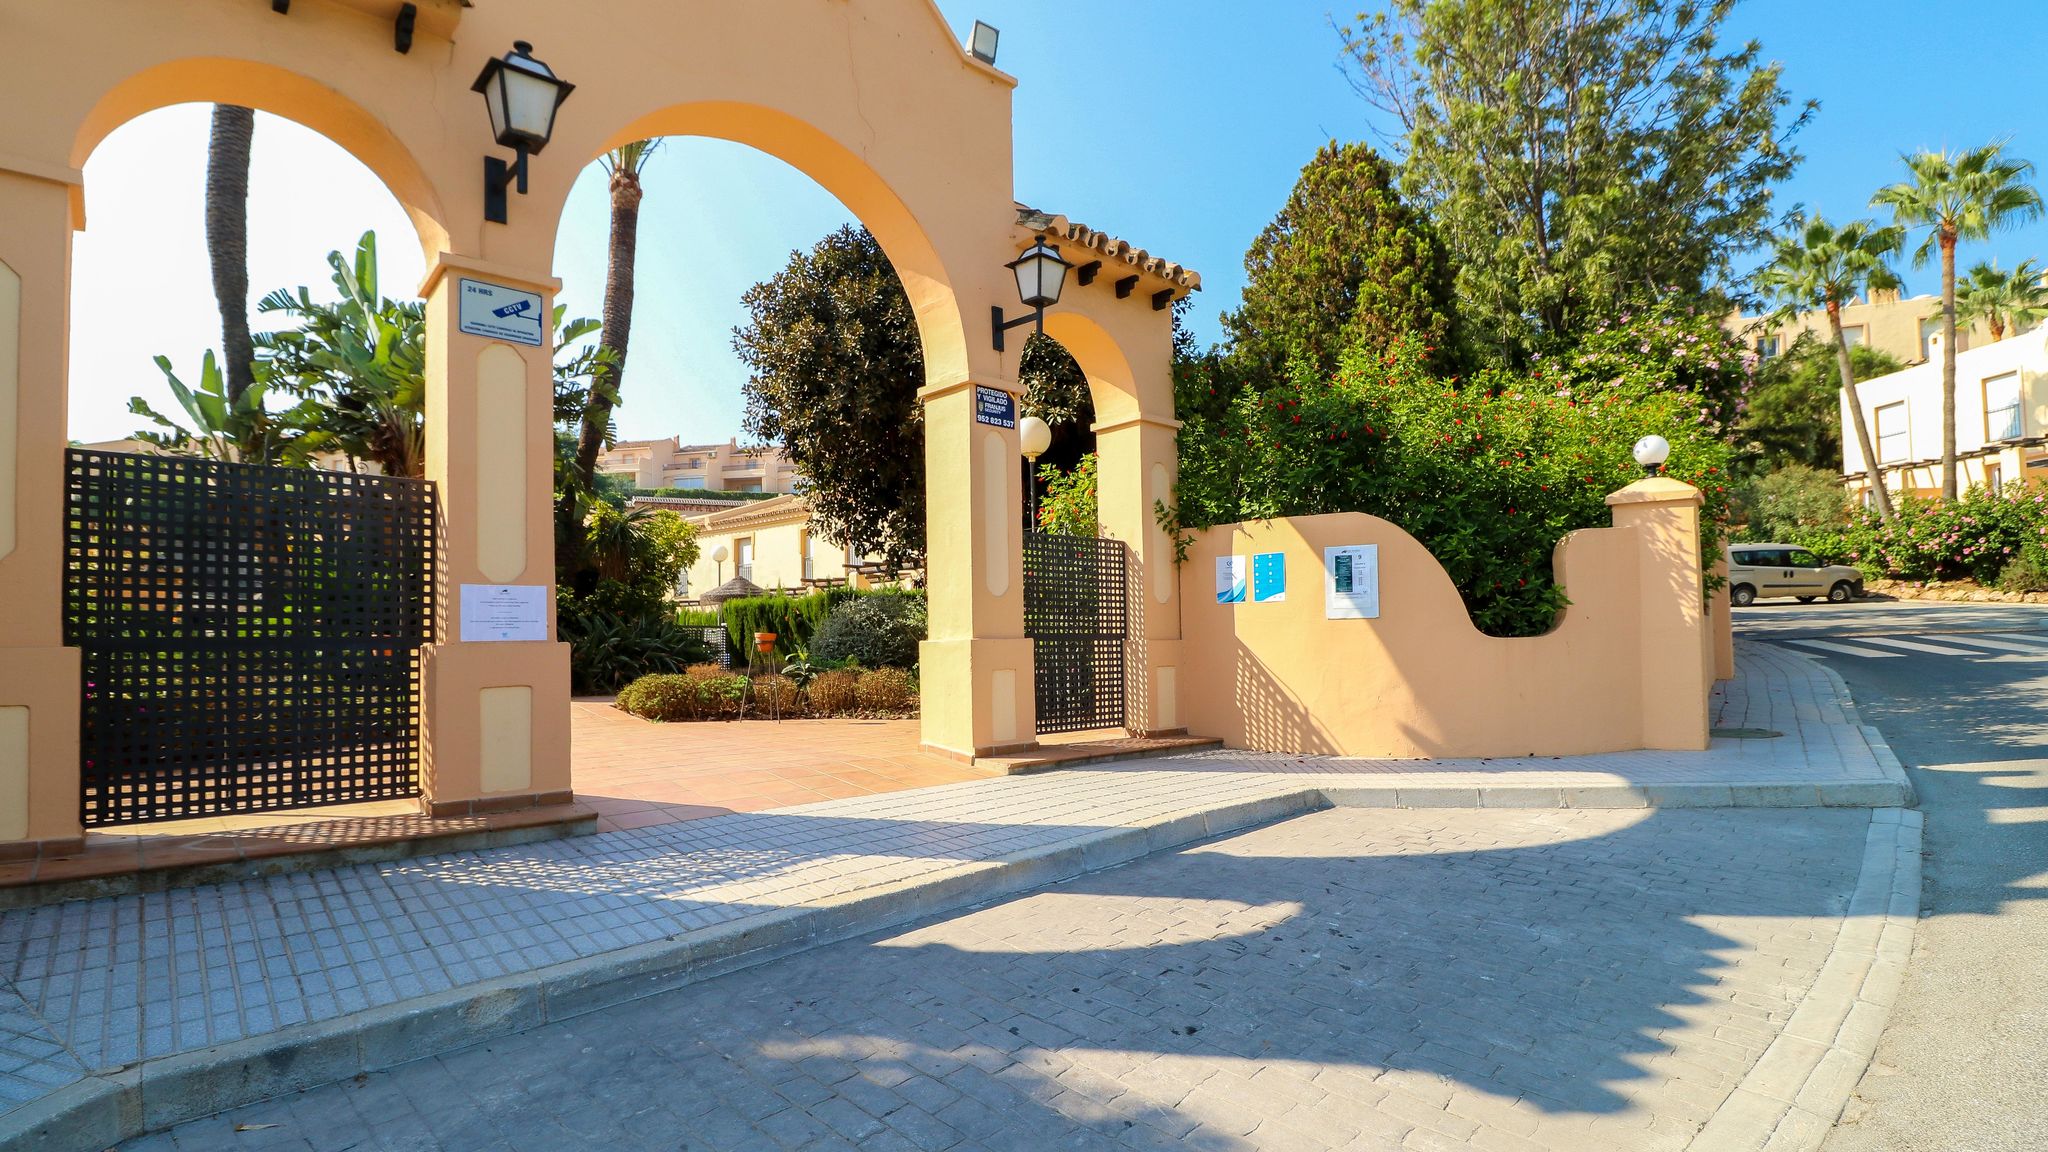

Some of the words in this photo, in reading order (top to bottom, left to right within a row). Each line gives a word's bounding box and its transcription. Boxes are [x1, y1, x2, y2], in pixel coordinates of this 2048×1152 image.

[467, 285, 476, 293] 24
[478, 288, 493, 296] HRS
[503, 303, 522, 314] CCTV
[977, 387, 1008, 399] PROTEGIDO
[983, 395, 1008, 406] VIGILADO
[977, 414, 989, 423] 952
[990, 417, 1002, 425] 823
[1003, 419, 1014, 428] 537
